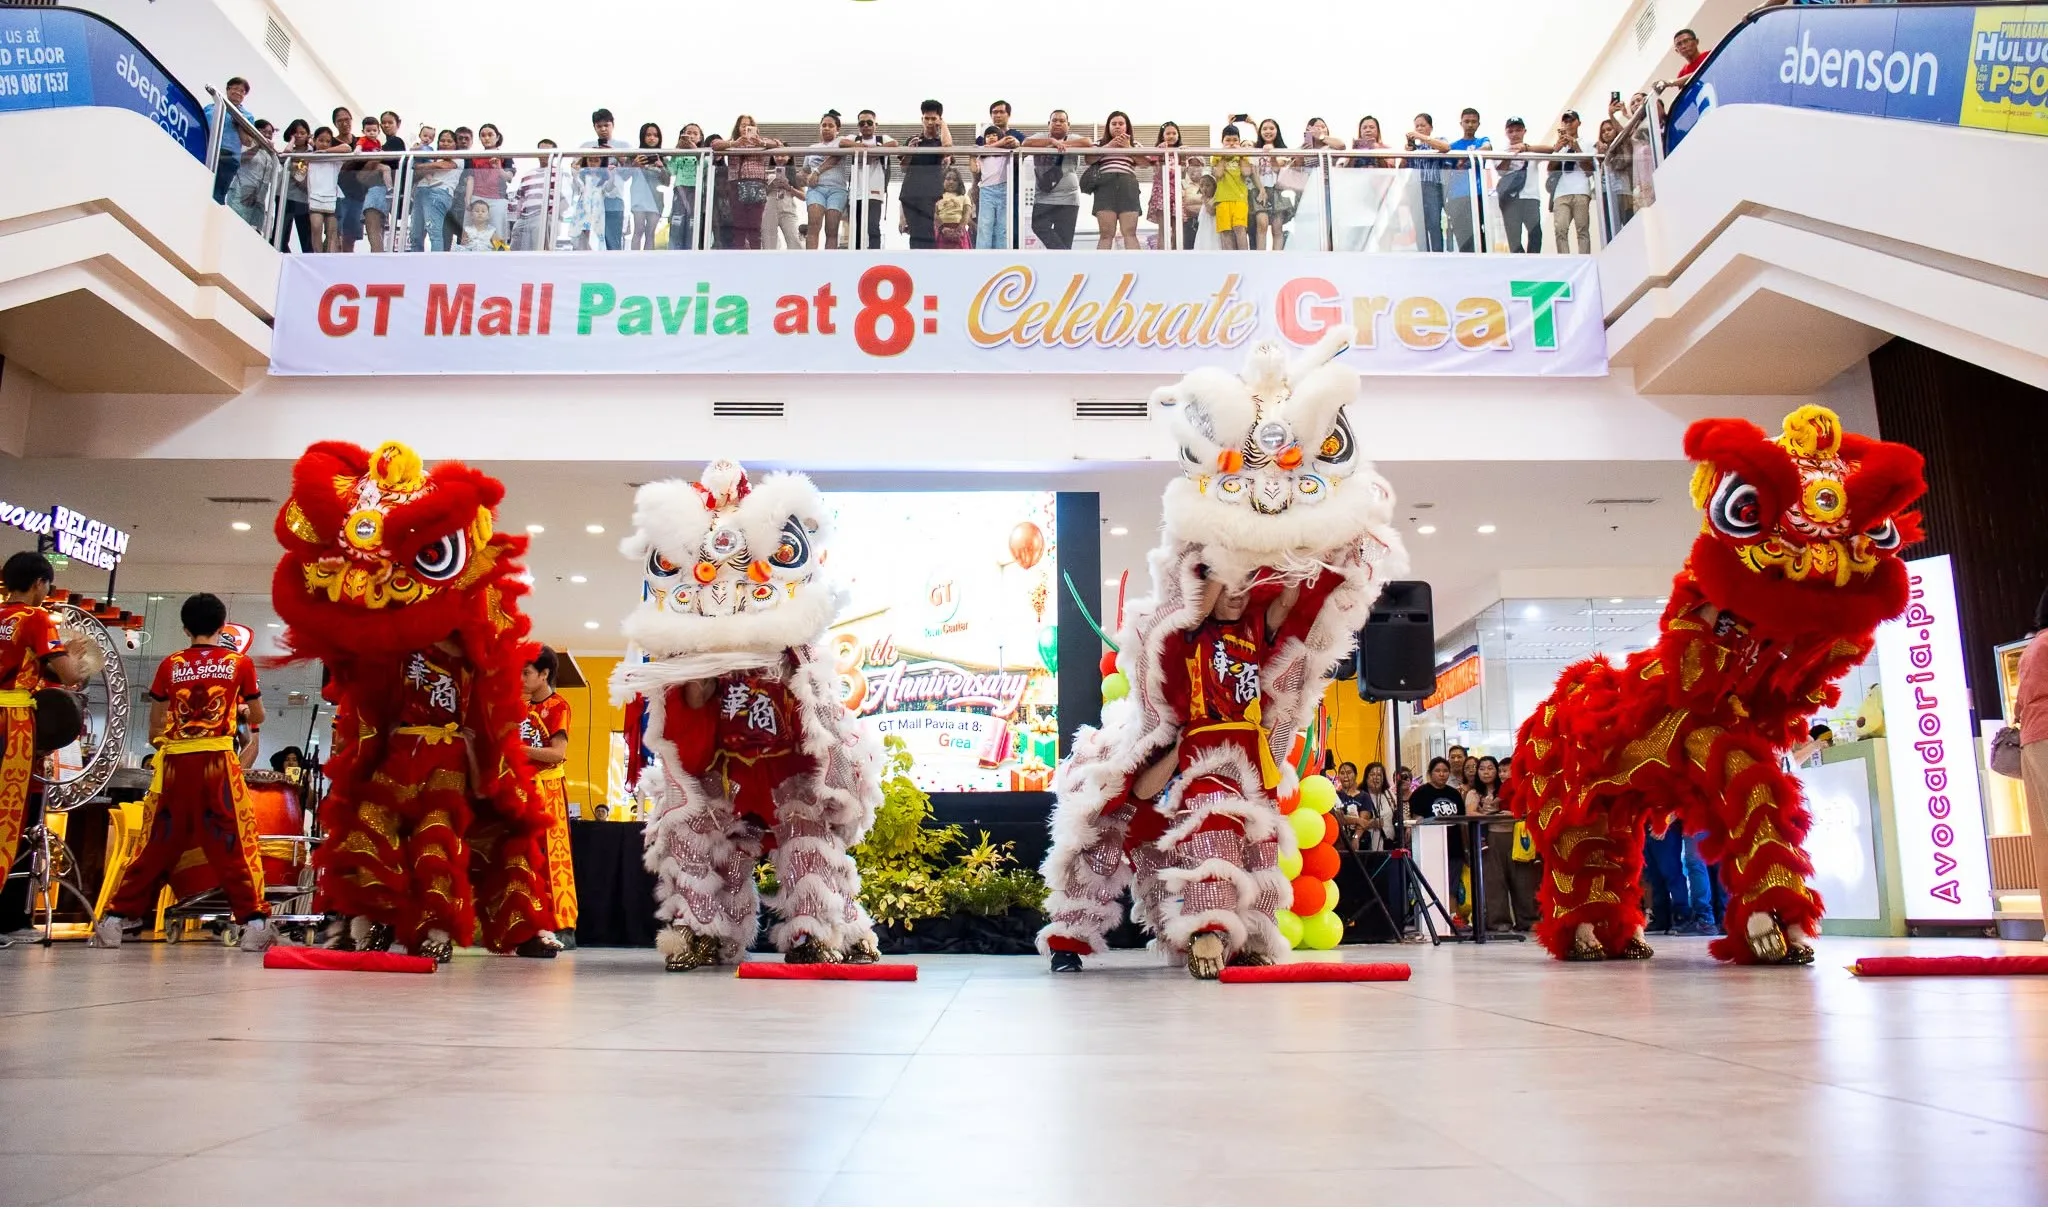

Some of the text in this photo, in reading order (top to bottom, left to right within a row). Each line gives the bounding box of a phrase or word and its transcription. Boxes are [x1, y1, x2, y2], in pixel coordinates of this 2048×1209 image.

[6, 29, 22, 44] us
[26, 27, 41, 44] at
[0, 46, 66, 66] D FLOOR
[1779, 30, 1939, 97] abenson
[21, 73, 42, 94] 087
[43, 72, 69, 93] 1537
[116, 54, 190, 138] abenson
[317, 263, 1575, 358] GT Mall Pavia at 8: Celebrate GreaT
[54, 505, 130, 555] BELGIAN
[58, 530, 117, 572] Waffles
[172, 664, 235, 678] HUA SIONG
[172, 675, 200, 684] COLLEGE
[862, 660, 1028, 719] Anniversary
[878, 720, 895, 733] GT
[898, 718, 922, 730] Mall
[925, 718, 955, 730] Pavia
[958, 720, 968, 731] at
